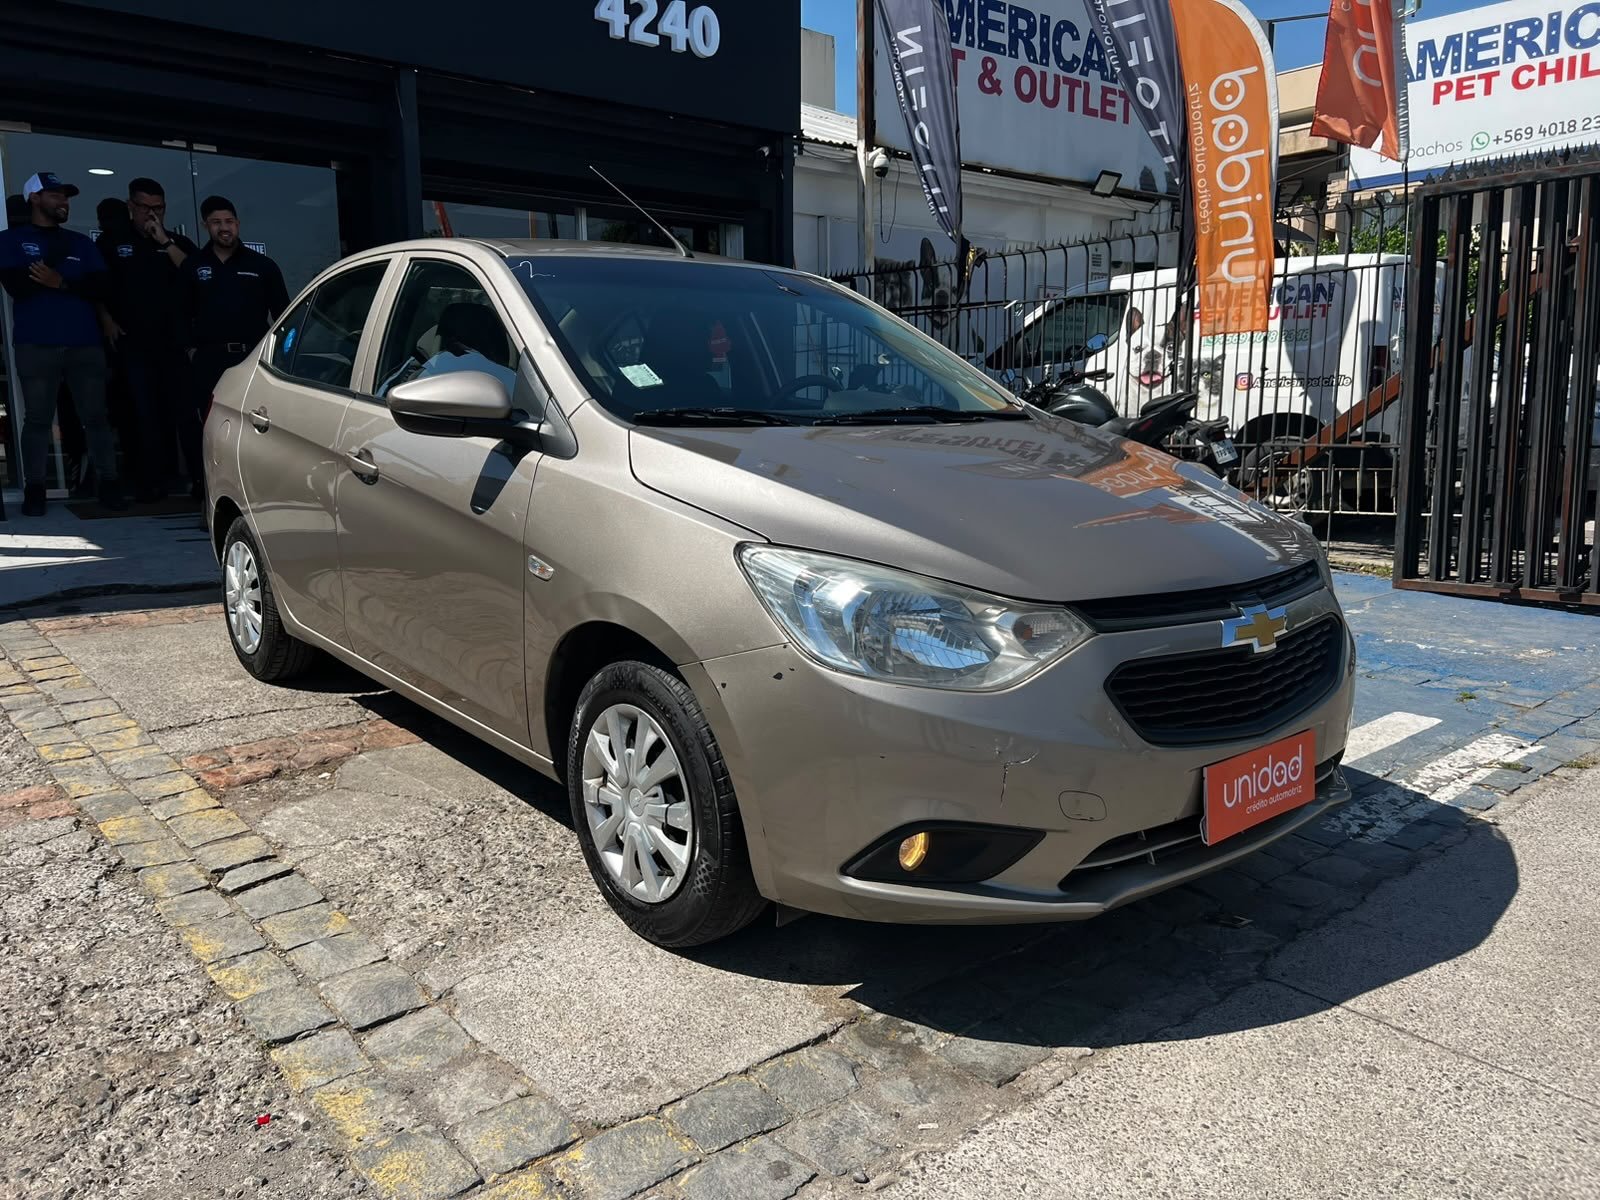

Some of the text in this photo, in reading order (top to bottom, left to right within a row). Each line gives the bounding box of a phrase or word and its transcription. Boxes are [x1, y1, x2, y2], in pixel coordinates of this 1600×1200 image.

[594, 0, 720, 58] 4240
[938, 0, 1118, 84] MERICA
[978, 56, 1003, 96] &
[1014, 65, 1131, 125] OUTLET
[1432, 70, 1500, 105] PET
[1493, 126, 1534, 144] +569
[1538, 119, 1577, 138] 4018
[1223, 743, 1303, 808] unidad
[1268, 784, 1302, 805] automotriz
